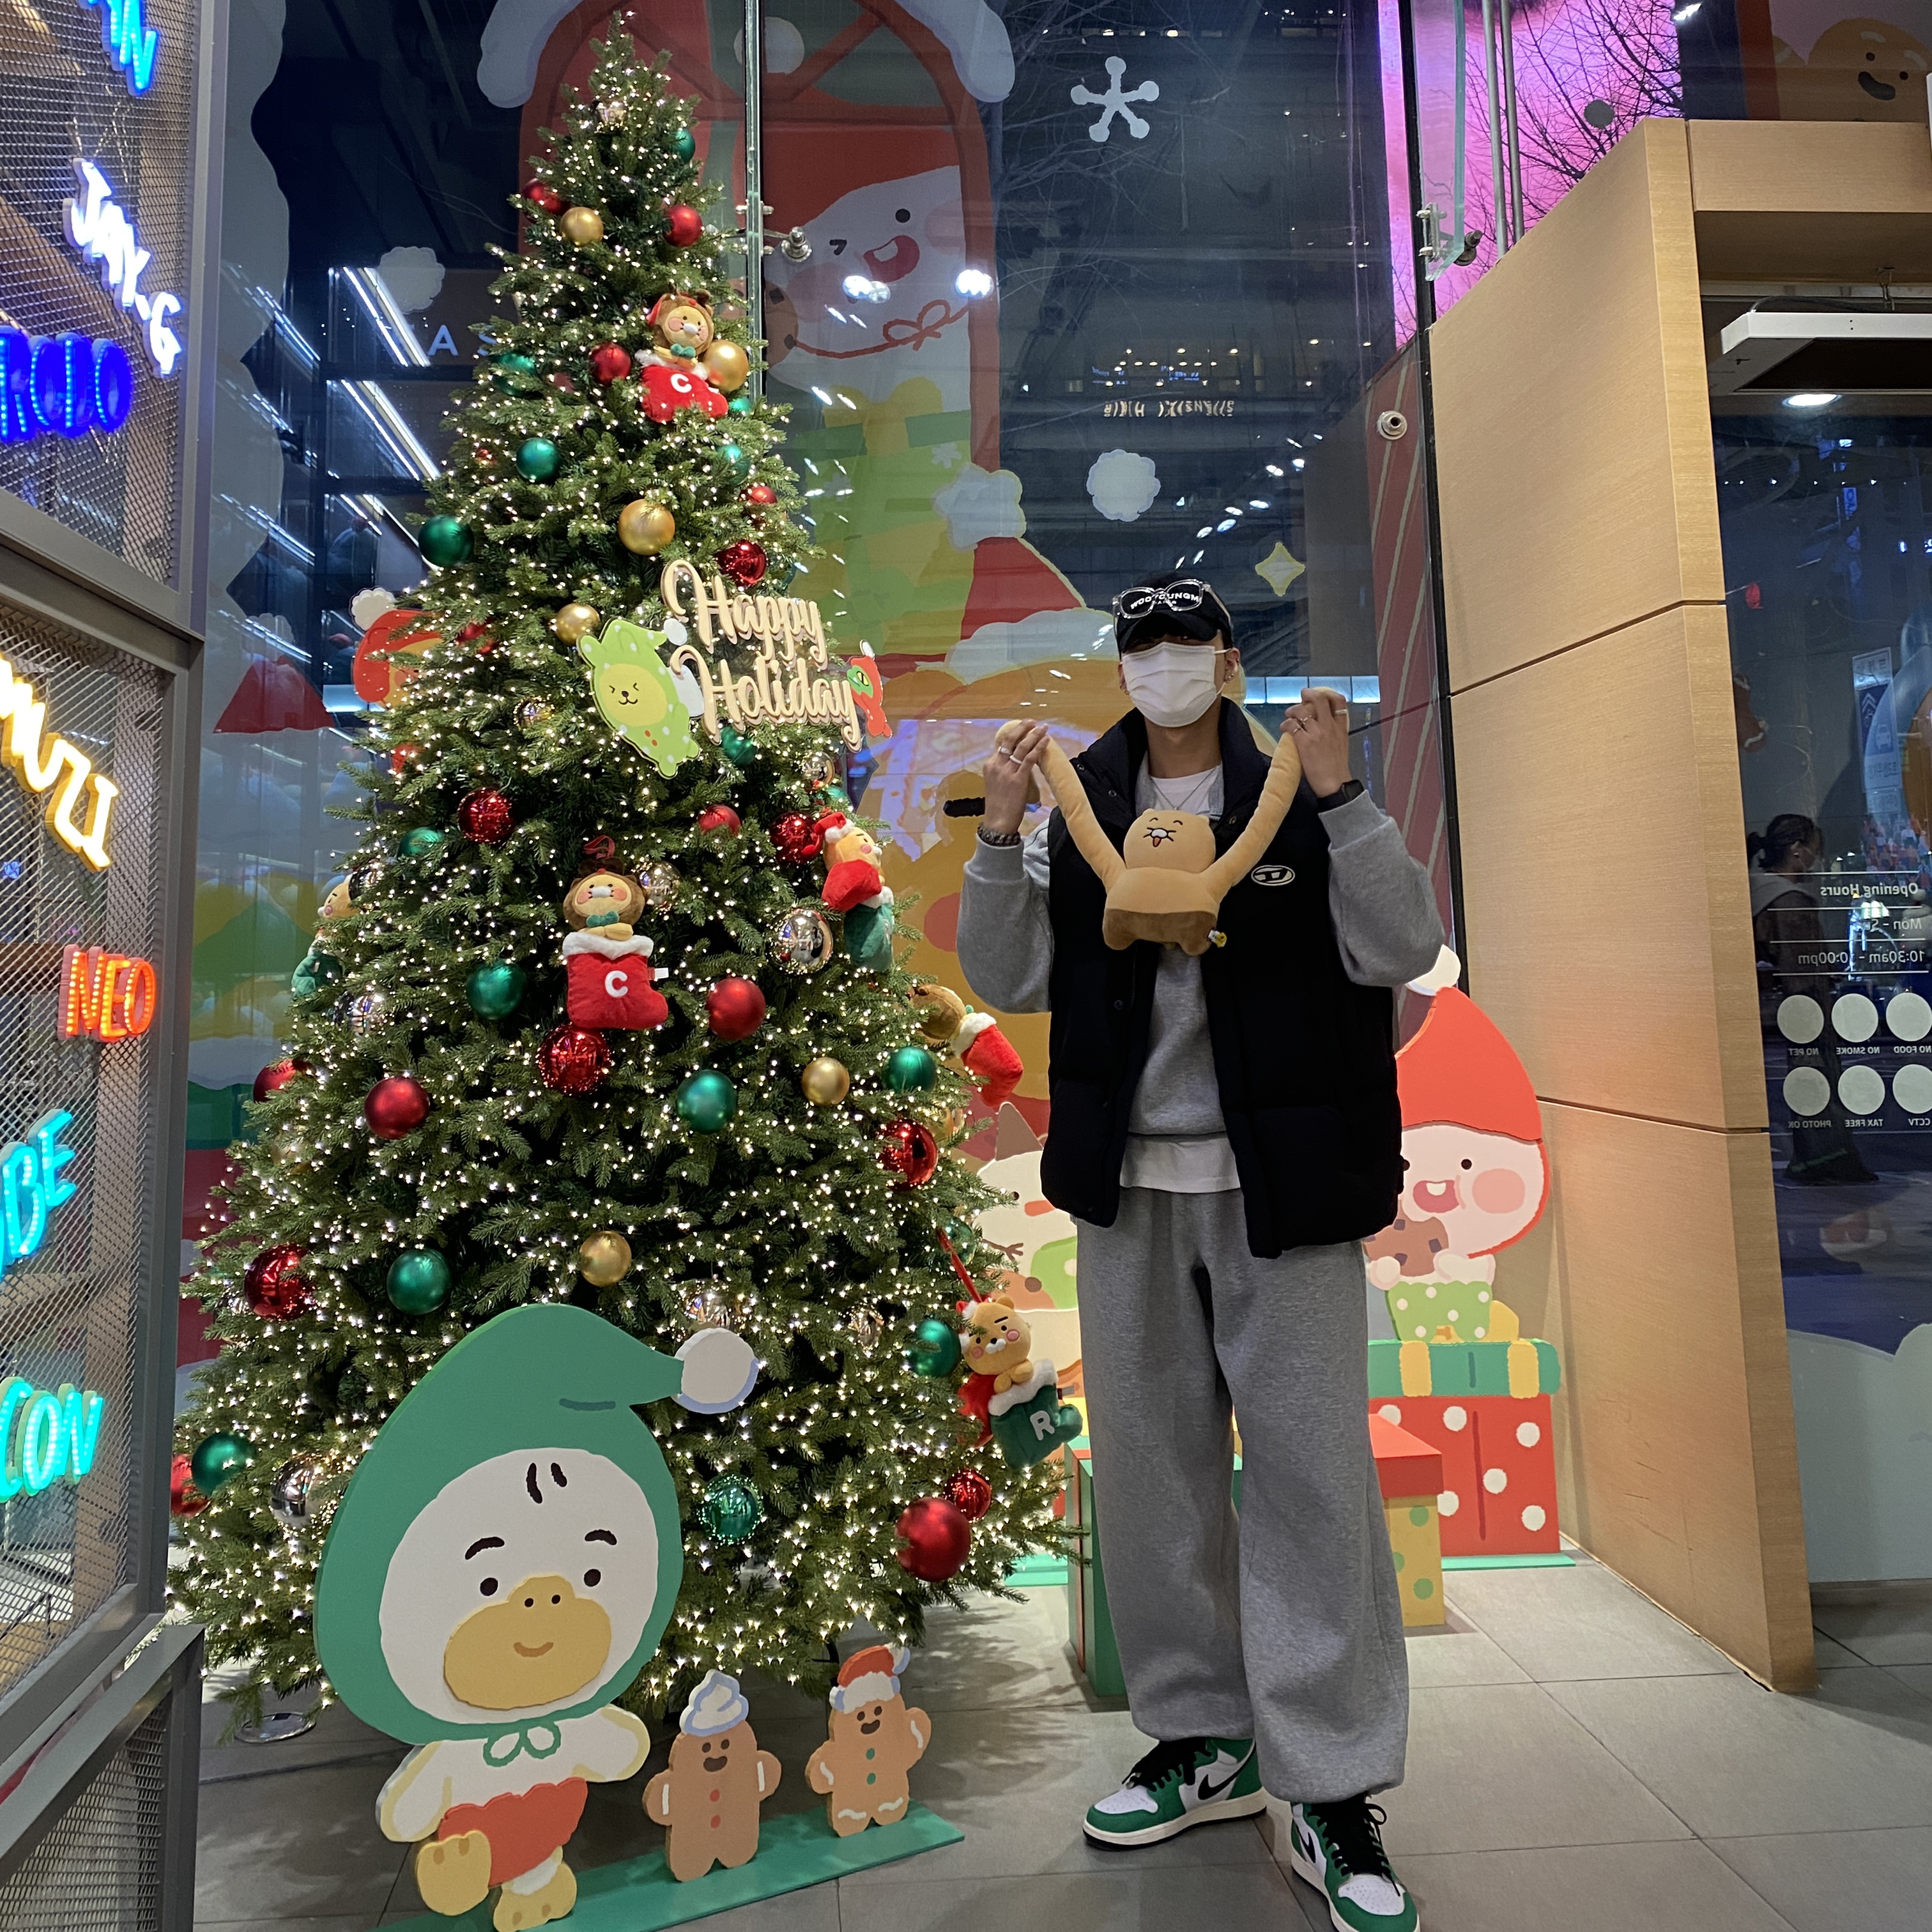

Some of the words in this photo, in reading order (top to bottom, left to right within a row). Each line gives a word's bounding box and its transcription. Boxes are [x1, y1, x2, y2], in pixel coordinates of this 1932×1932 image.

[670, 374, 692, 393] C
[661, 560, 828, 670] Happy
[670, 645, 862, 752] Holiday
[59, 944, 156, 1042] NEO
[604, 970, 629, 998] C
[1029, 1410, 1055, 1441] R
